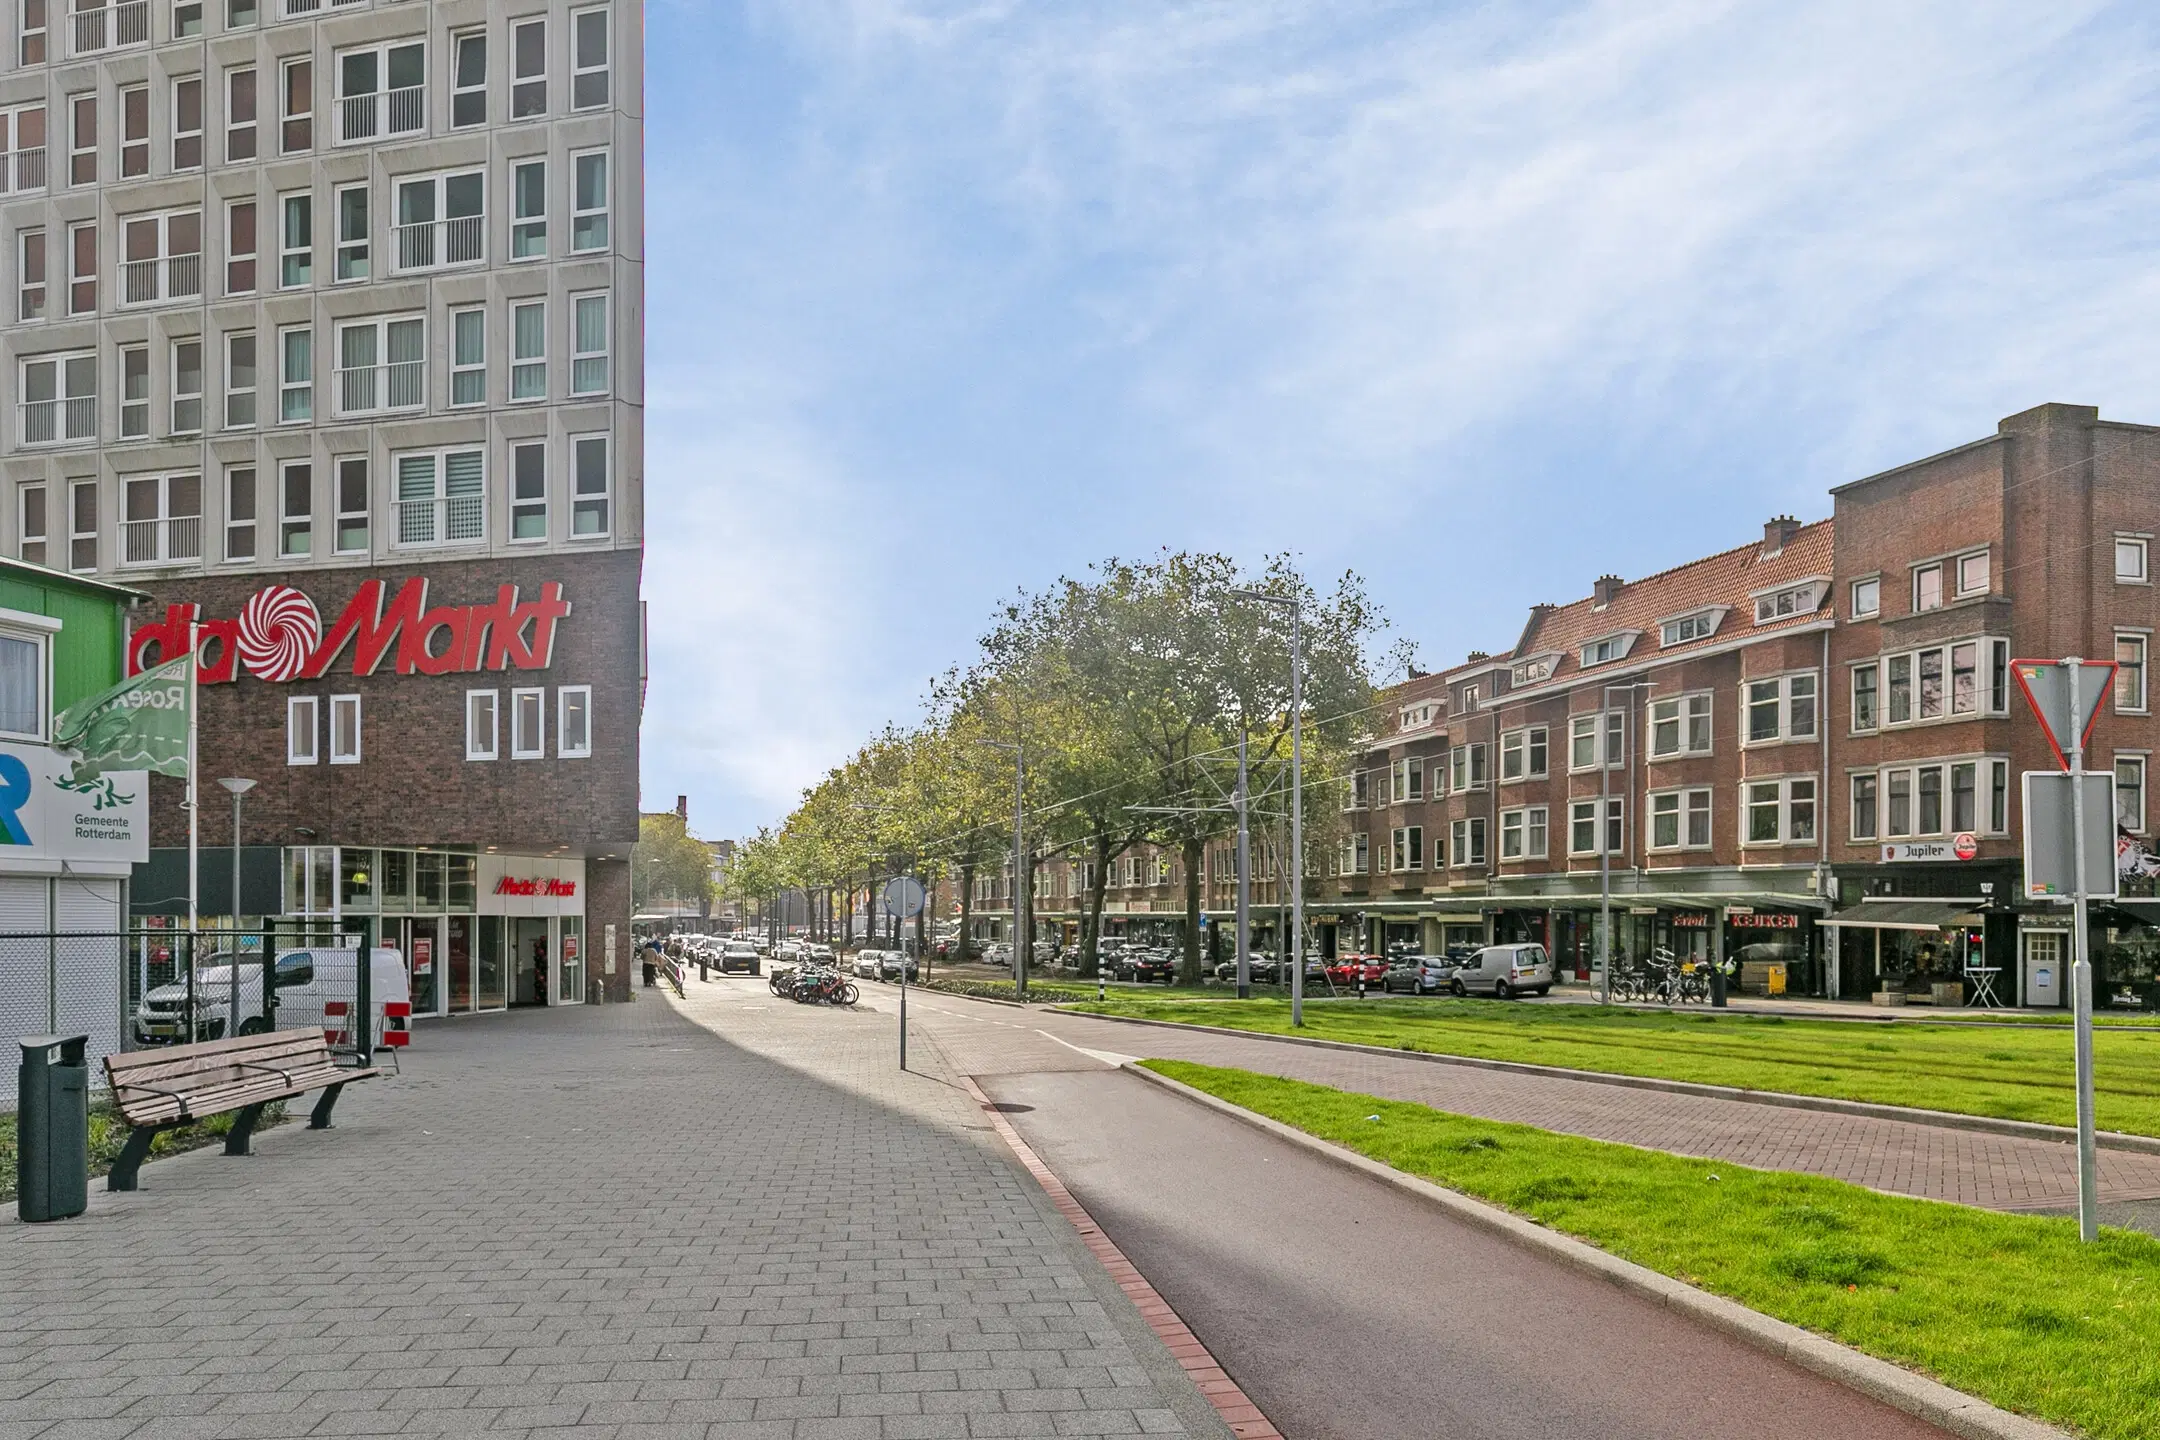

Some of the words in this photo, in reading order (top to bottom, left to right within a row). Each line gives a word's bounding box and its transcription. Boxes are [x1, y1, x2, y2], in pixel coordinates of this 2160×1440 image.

[302, 577, 571, 678] Markt
[74, 813, 129, 827] Gemeente
[75, 827, 131, 840] Rotterdam
[1905, 844, 1945, 859] Jupiler
